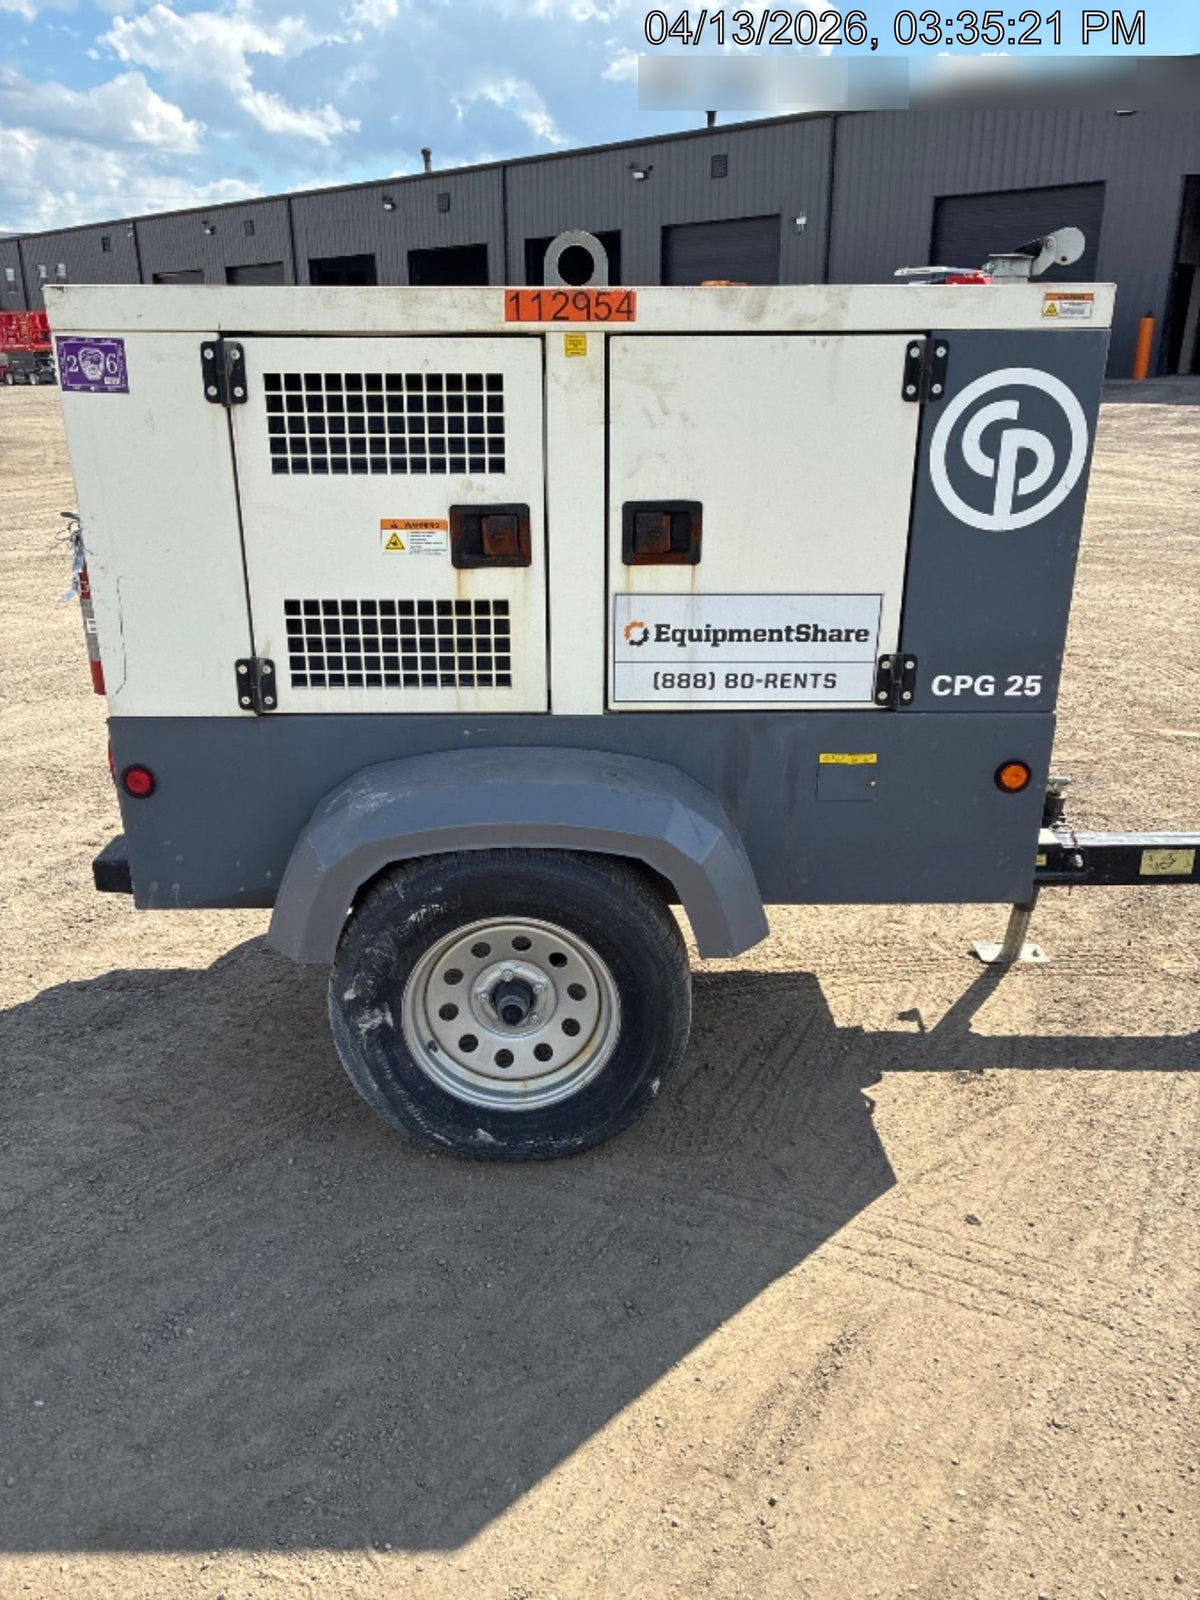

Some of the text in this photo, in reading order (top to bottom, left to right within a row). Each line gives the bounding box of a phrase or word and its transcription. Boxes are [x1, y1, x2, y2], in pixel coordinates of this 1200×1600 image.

[508, 290, 634, 321] 112954
[654, 623, 870, 647] EquipmentShare
[653, 671, 838, 690] (888) 80-RENTS
[931, 675, 1043, 697] CPG 25
